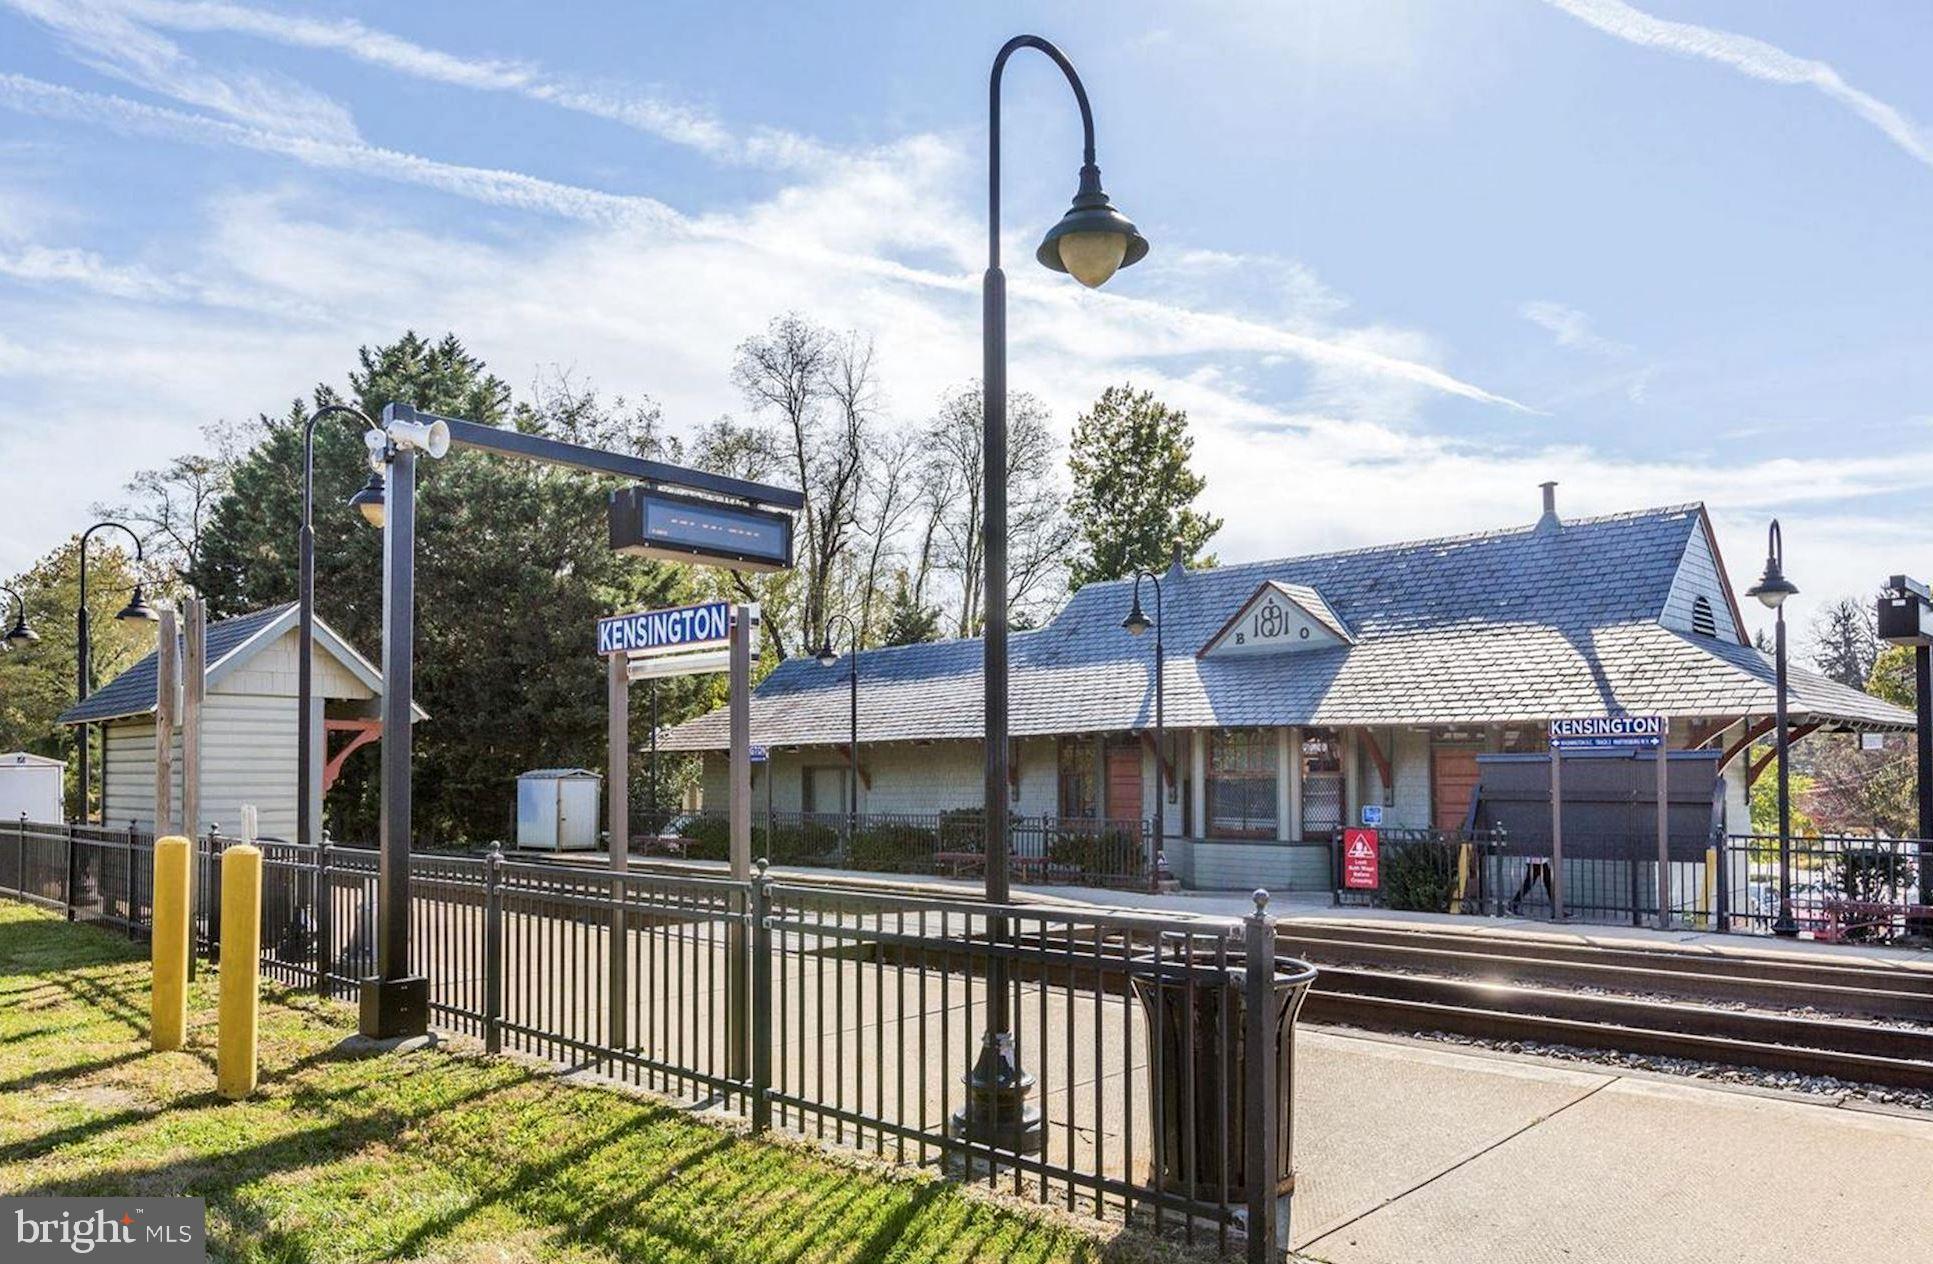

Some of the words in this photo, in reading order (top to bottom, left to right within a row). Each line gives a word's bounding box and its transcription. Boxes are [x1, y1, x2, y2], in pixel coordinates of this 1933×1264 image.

[600, 605, 726, 651] KENSINGTON
[1253, 605, 1289, 637] 1891
[1235, 632, 1245, 644] B
[1551, 718, 1660, 734] KENSINGTON
